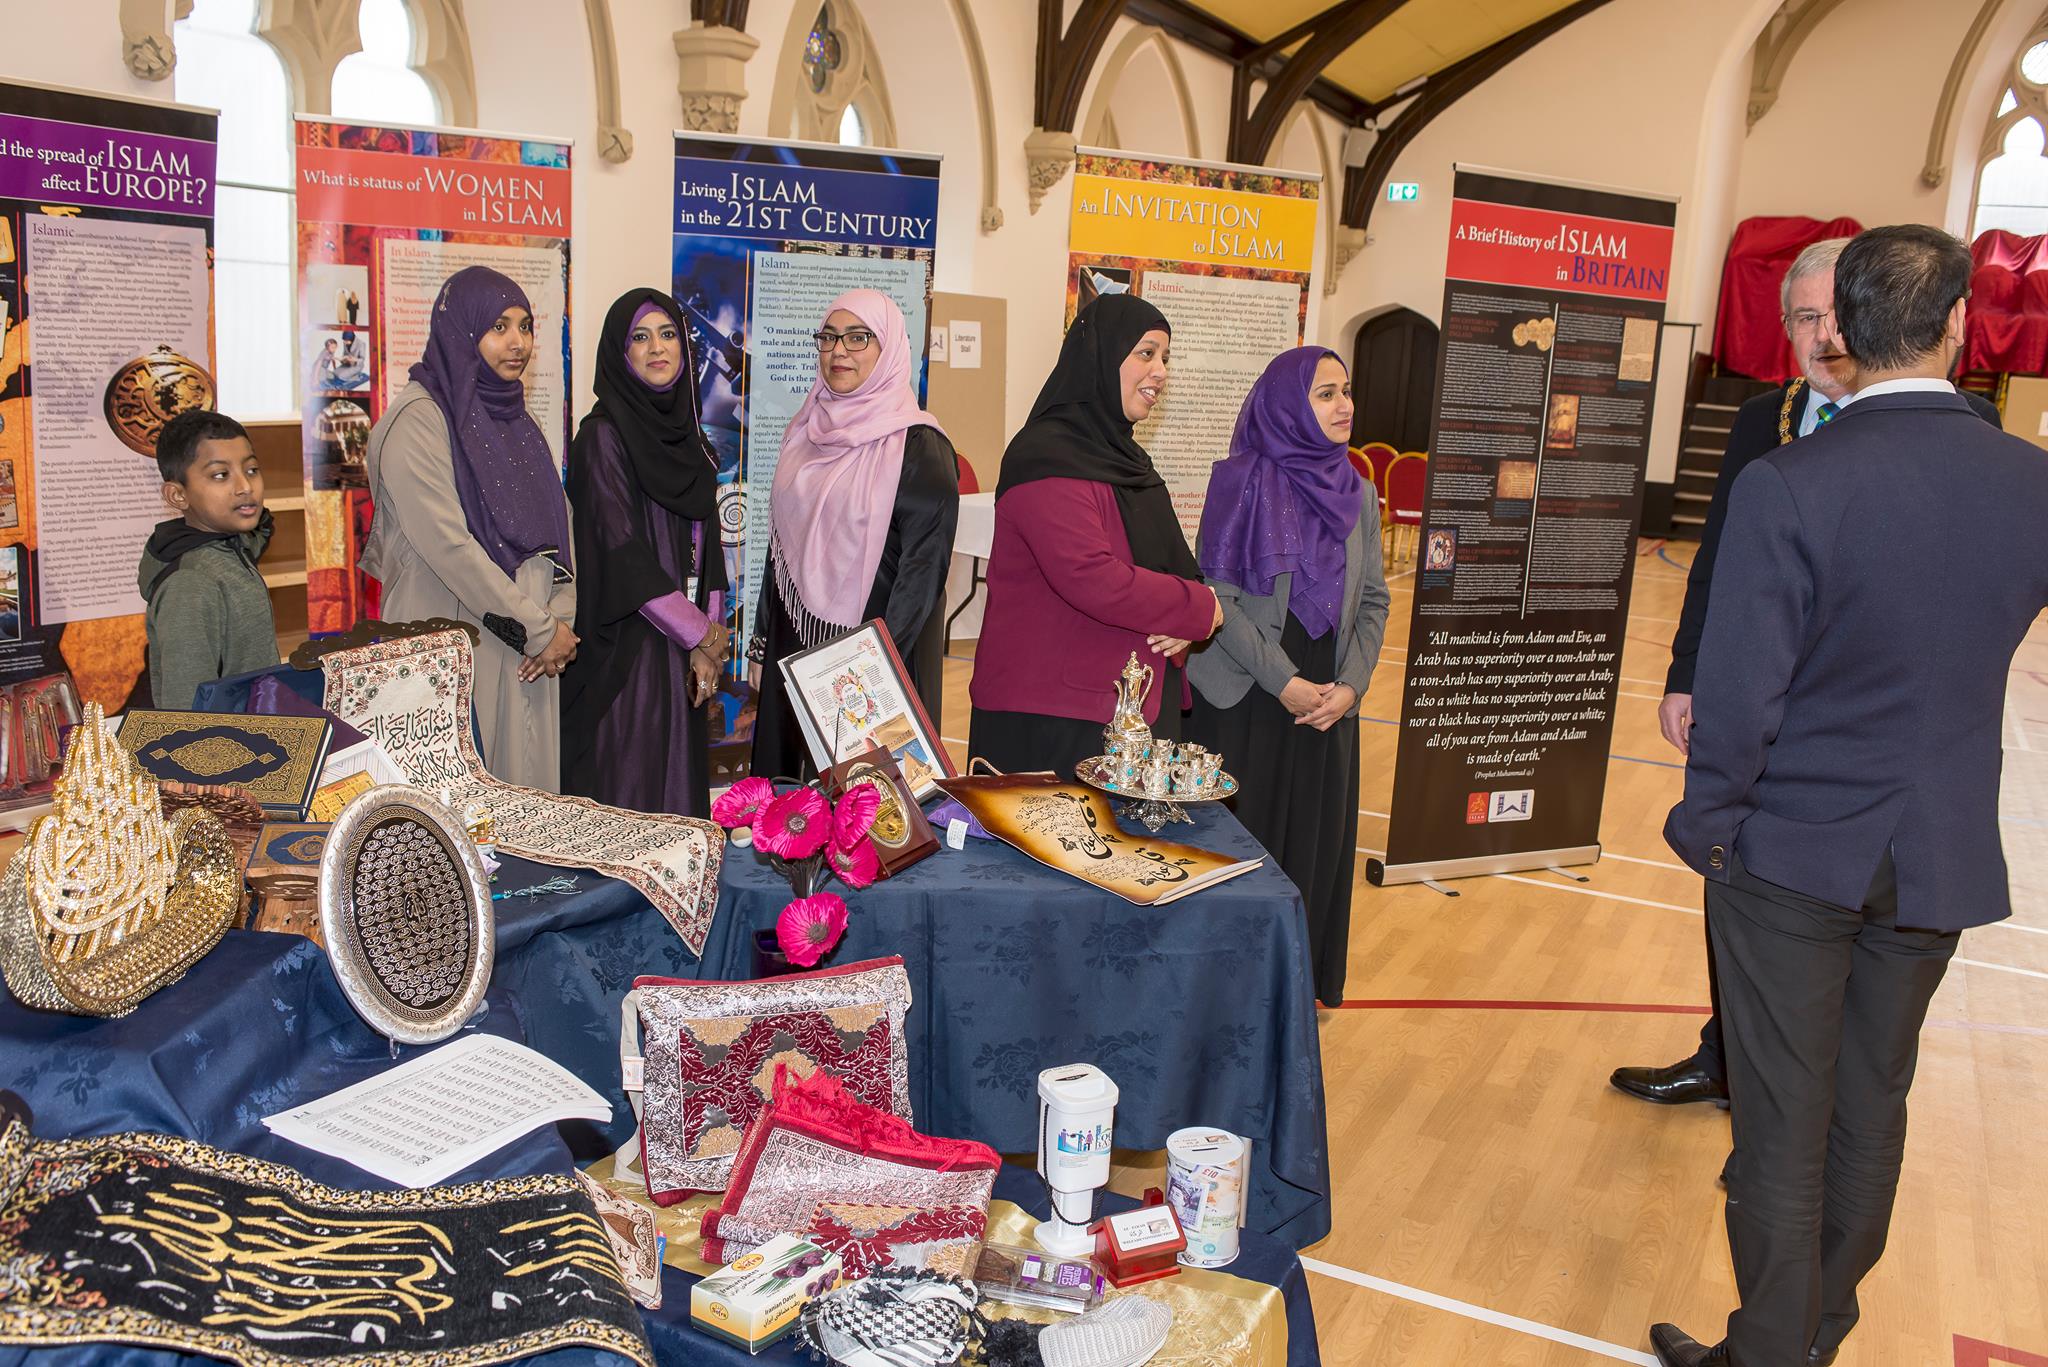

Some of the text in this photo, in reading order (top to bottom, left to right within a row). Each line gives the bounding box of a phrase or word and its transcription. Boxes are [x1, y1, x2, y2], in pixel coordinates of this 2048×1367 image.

[11, 142, 33, 158] the
[38, 147, 84, 166] spread
[89, 151, 104, 166] of
[106, 140, 191, 177] ISLAM
[42, 165, 207, 206] affect EUROPE?
[304, 167, 544, 201] What is status of WOMEN
[681, 172, 817, 204] Living ISLAM
[463, 195, 564, 227] in ISLAM
[1079, 189, 1261, 229] An INVITATION
[33, 223, 74, 237] Islamic
[681, 202, 931, 239] in the 21ST CENTURY
[1193, 230, 1284, 261] to ISLAM
[1456, 224, 1627, 259] A Brief History of ISLAM
[391, 247, 431, 258] In Islam
[761, 257, 789, 269] Islam
[1557, 256, 1664, 290] in BRITAIN
[1149, 280, 1183, 293] Islamic
[776, 326, 811, 337] mankind,
[760, 337, 779, 346] male
[781, 338, 794, 347] and
[766, 349, 810, 359] nations and
[766, 361, 797, 370] another.
[770, 373, 807, 382] God is the
[1429, 630, 1606, 647] “All mankind is from Adam and Eve, an
[1413, 649, 1614, 667] Arab has no superiority over a non-Arab nor
[1410, 668, 1614, 687] a non-Arab has any superiority over an Arab;
[1414, 687, 1605, 706] also a white has no superiority over a black
[1409, 707, 1605, 727] nor a black has any superiority over a white;
[1426, 726, 1586, 749] all of you are from Adam and Adam
[1466, 747, 1546, 766] is made of earth.”
[1474, 770, 1496, 780] (Prophet
[1202, 1167, 1219, 1179] £10
[720, 1277, 742, 1293] Iranian
[742, 1268, 759, 1281] Dates
[1062, 1265, 1071, 1286] DATES
[765, 1301, 782, 1315] Iranian
[782, 1292, 797, 1306] Dates
